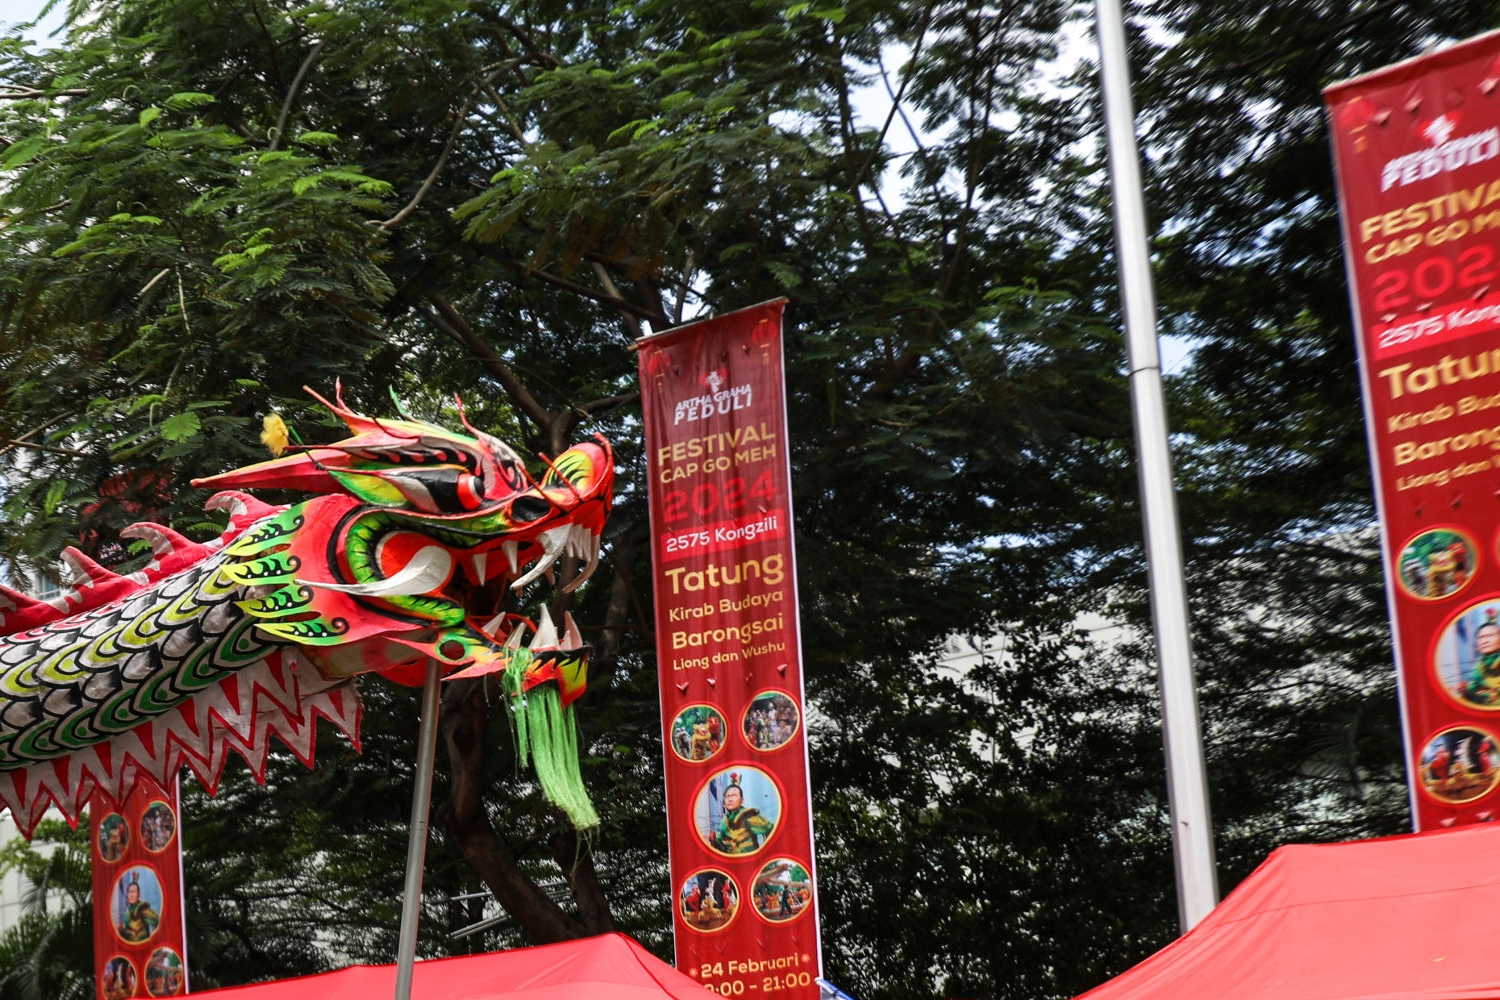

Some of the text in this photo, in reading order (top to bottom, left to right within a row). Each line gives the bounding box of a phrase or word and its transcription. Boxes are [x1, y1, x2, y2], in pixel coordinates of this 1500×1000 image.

[1365, 232, 1423, 264] CAP
[1425, 219, 1470, 247] GO
[1373, 243, 1500, 312] 202
[1378, 315, 1444, 349] 2575
[674, 393, 752, 426] PEDULI
[675, 383, 752, 412] ARTHA GRAHA
[1387, 403, 1454, 434] Kirab
[658, 422, 776, 467] FESTIVAL
[660, 444, 777, 484] CAP GO MEH
[663, 468, 779, 523] 2024
[666, 515, 779, 553] 2575 Kongzili
[664, 552, 785, 595] Tatung
[669, 590, 784, 623] Kirab Budaya
[672, 613, 784, 650] Barongsai
[673, 641, 786, 671] Liong dan Wushu
[701, 952, 799, 979] 24 Februari
[762, 972, 811, 993] 21:00
